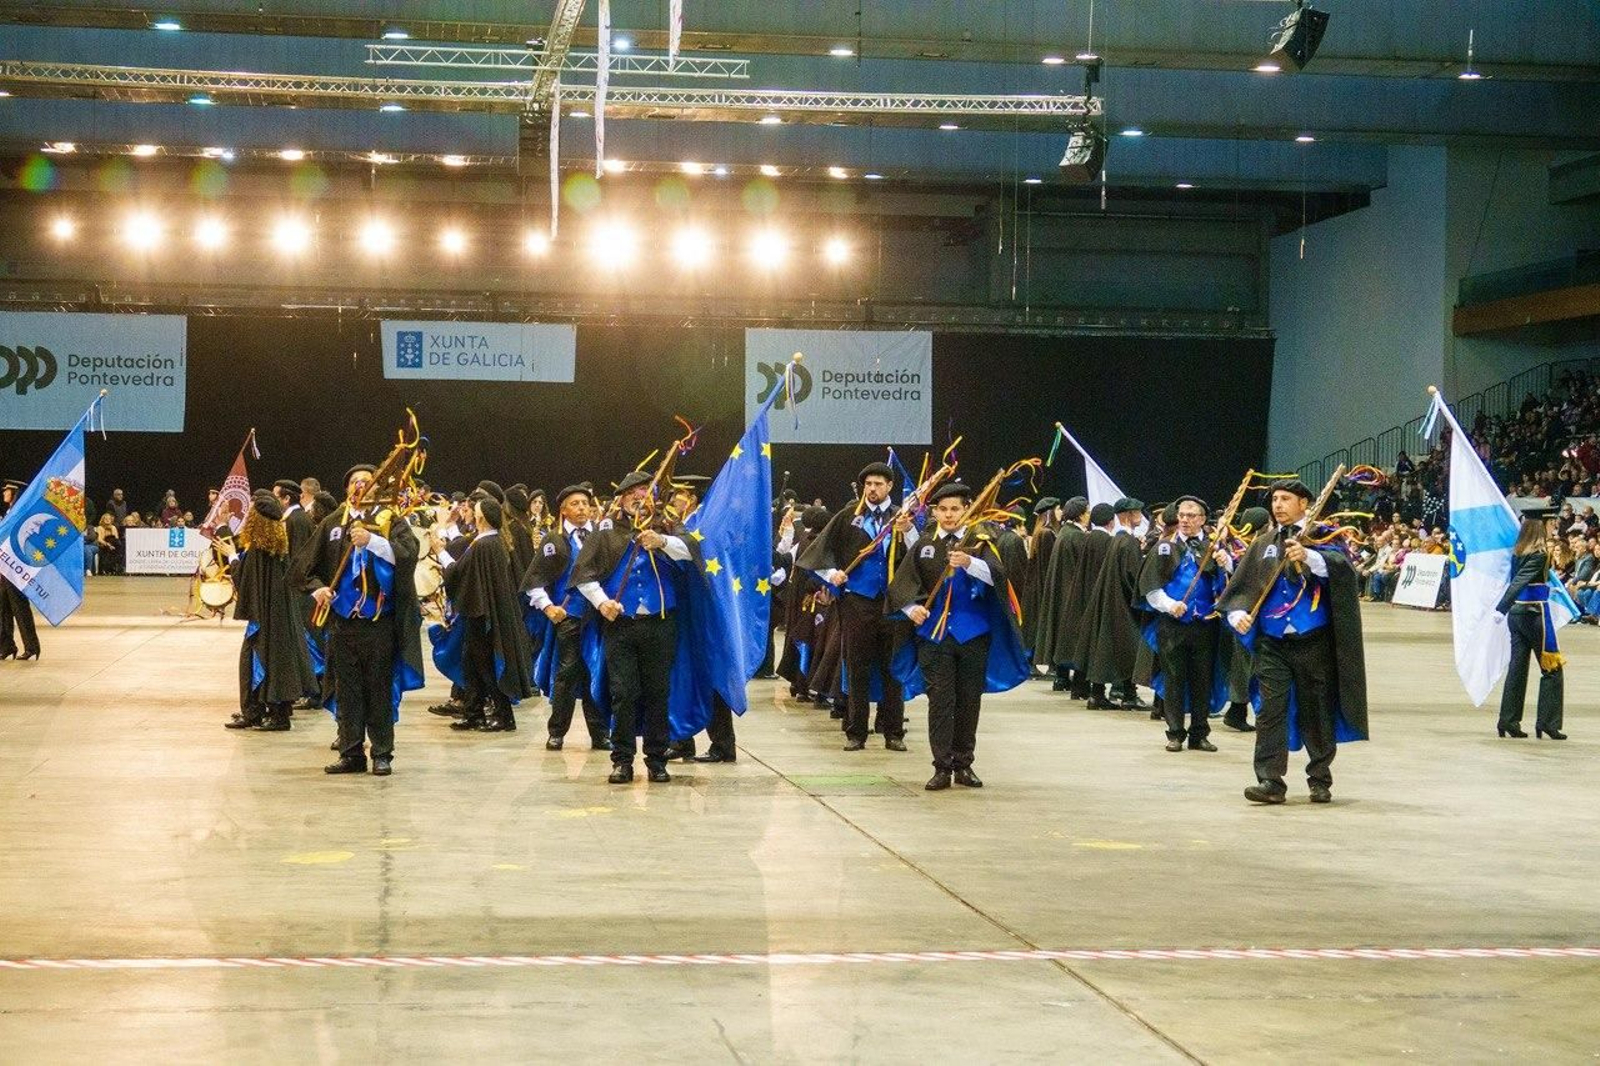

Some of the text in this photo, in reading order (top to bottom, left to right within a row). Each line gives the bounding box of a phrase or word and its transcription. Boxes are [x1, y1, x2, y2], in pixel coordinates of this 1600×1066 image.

[430, 335, 489, 349] XUNTA
[68, 354, 174, 372] Deputación
[429, 352, 526, 366] DE GALICIA
[68, 372, 174, 386] Pontevedra
[822, 369, 921, 387] Deputación
[821, 387, 921, 401] Pontevedra
[136, 550, 166, 558] XUNTA
[168, 550, 180, 558] DE
[21, 573, 36, 586] DE
[35, 585, 50, 600] TUI
